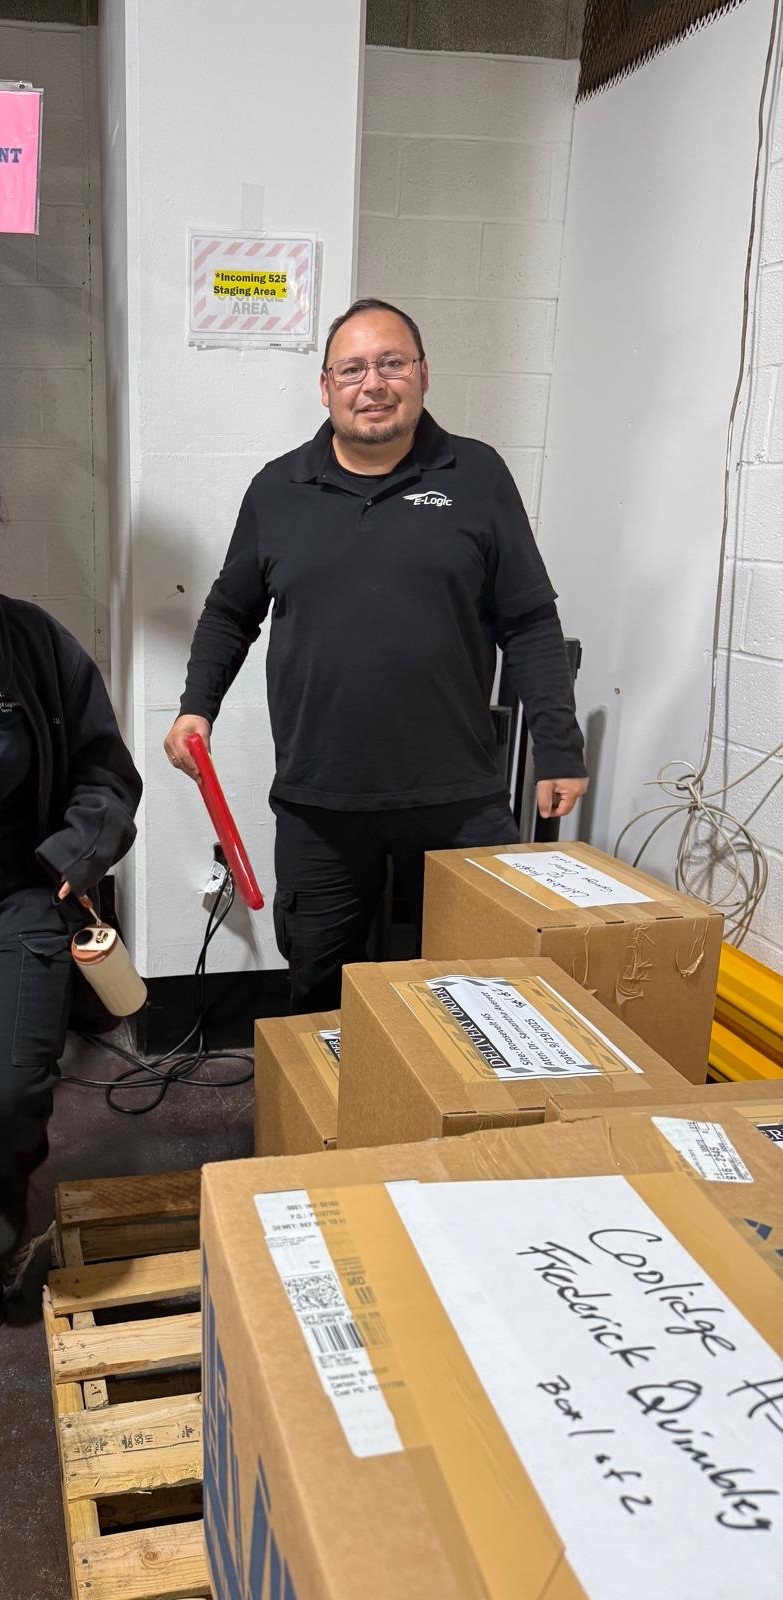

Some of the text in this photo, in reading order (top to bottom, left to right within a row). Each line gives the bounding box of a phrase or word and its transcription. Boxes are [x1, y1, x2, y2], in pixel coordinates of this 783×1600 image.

[213, 285, 276, 296] Staging Area
[268, 274, 287, 283] 525
[232, 302, 269, 315] AREA
[413, 496, 453, 507] E-Logic
[433, 988, 507, 1067] DELIVERY ORDER
[480, 1013, 534, 1066] Site: Roosevelt HS
[501, 1012, 531, 1040] Samantha
[525, 1018, 577, 1065] Date: 9/19/2025
[527, 1041, 540, 1050] Dr.
[535, 1051, 556, 1066] Attn:
[516, 1241, 656, 1368] Frederick
[588, 1228, 737, 1358] Coolidge
[536, 1374, 583, 1422] Box
[619, 1495, 653, 1515] 2
